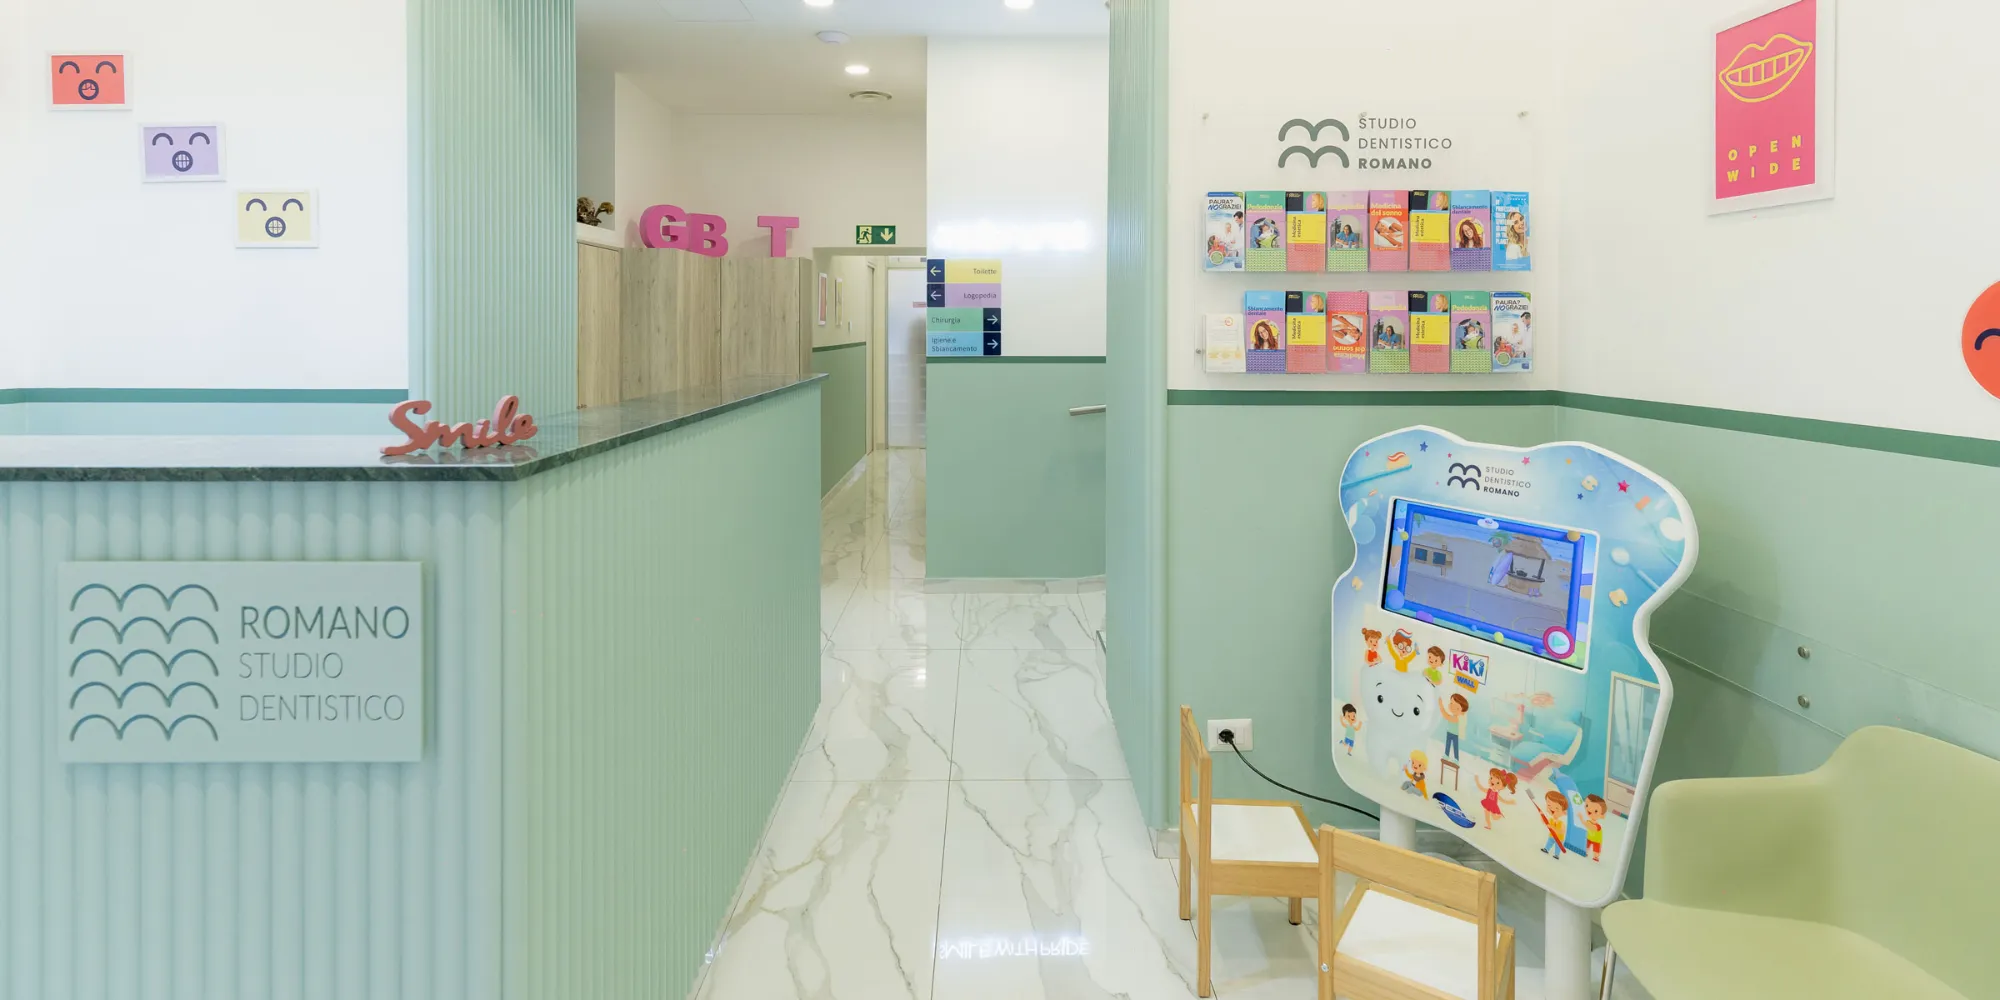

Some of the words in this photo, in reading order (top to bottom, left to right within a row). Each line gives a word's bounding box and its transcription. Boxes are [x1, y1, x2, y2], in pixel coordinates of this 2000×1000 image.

[1358, 117, 1417, 129] STUDIO
[1358, 138, 1452, 149] DENTISTICO
[1728, 135, 1802, 161] OPEN
[1358, 158, 1432, 169] ROMANO
[1727, 157, 1801, 182] WIDE
[757, 216, 800, 257] T
[963, 292, 997, 300] Logopedia
[931, 317, 961, 325] Chirurgia
[379, 395, 538, 456] Smile
[1485, 466, 1515, 476] STUDIO
[1484, 476, 1531, 488] DENTISTICO
[1483, 486, 1520, 497] ROMANO
[240, 605, 410, 640] ROMANO
[239, 652, 343, 679] STUDIO
[1456, 675, 1475, 688] WALL
[239, 694, 405, 722] DENTISTICO
